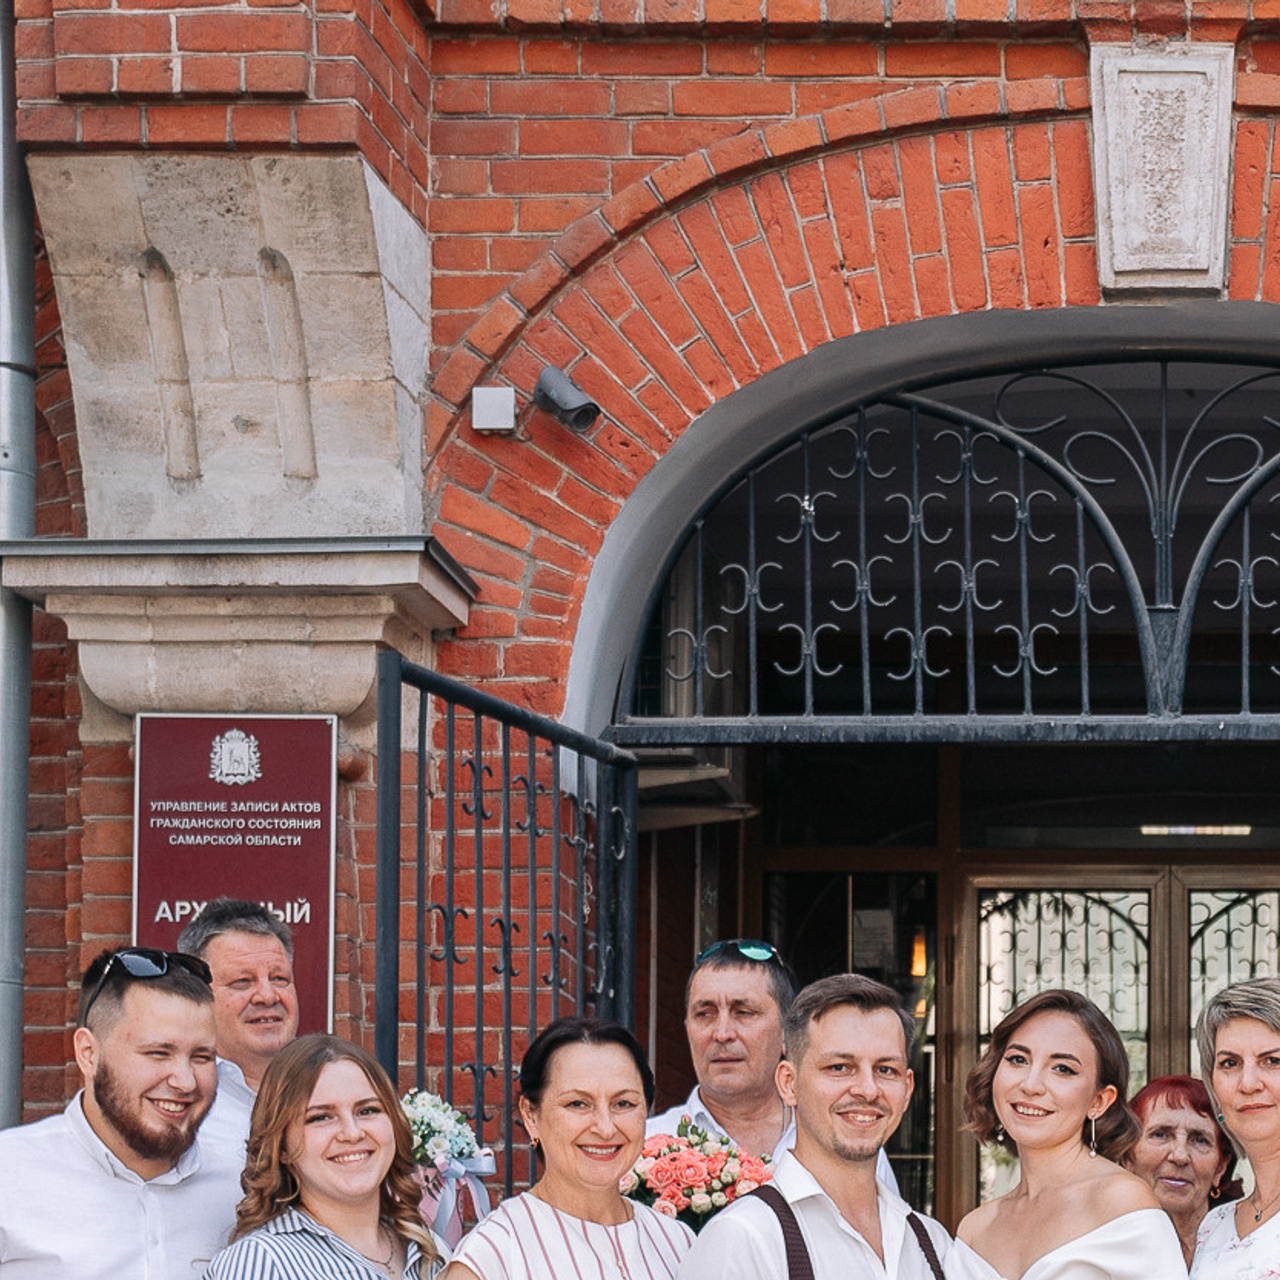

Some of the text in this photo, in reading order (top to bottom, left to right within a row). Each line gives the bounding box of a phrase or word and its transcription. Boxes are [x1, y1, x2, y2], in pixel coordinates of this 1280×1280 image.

[150, 801, 321, 813] УПРАВЛЕНИЕ ЗАПИСИ АКТОВ
[150, 818, 321, 830] ГРАЖДАНСКОГО СОСТОЯНИЯ
[169, 833, 301, 846] САМАРСКОЙ ОБЛАСТИ
[154, 898, 311, 924] АРХЫЙ
